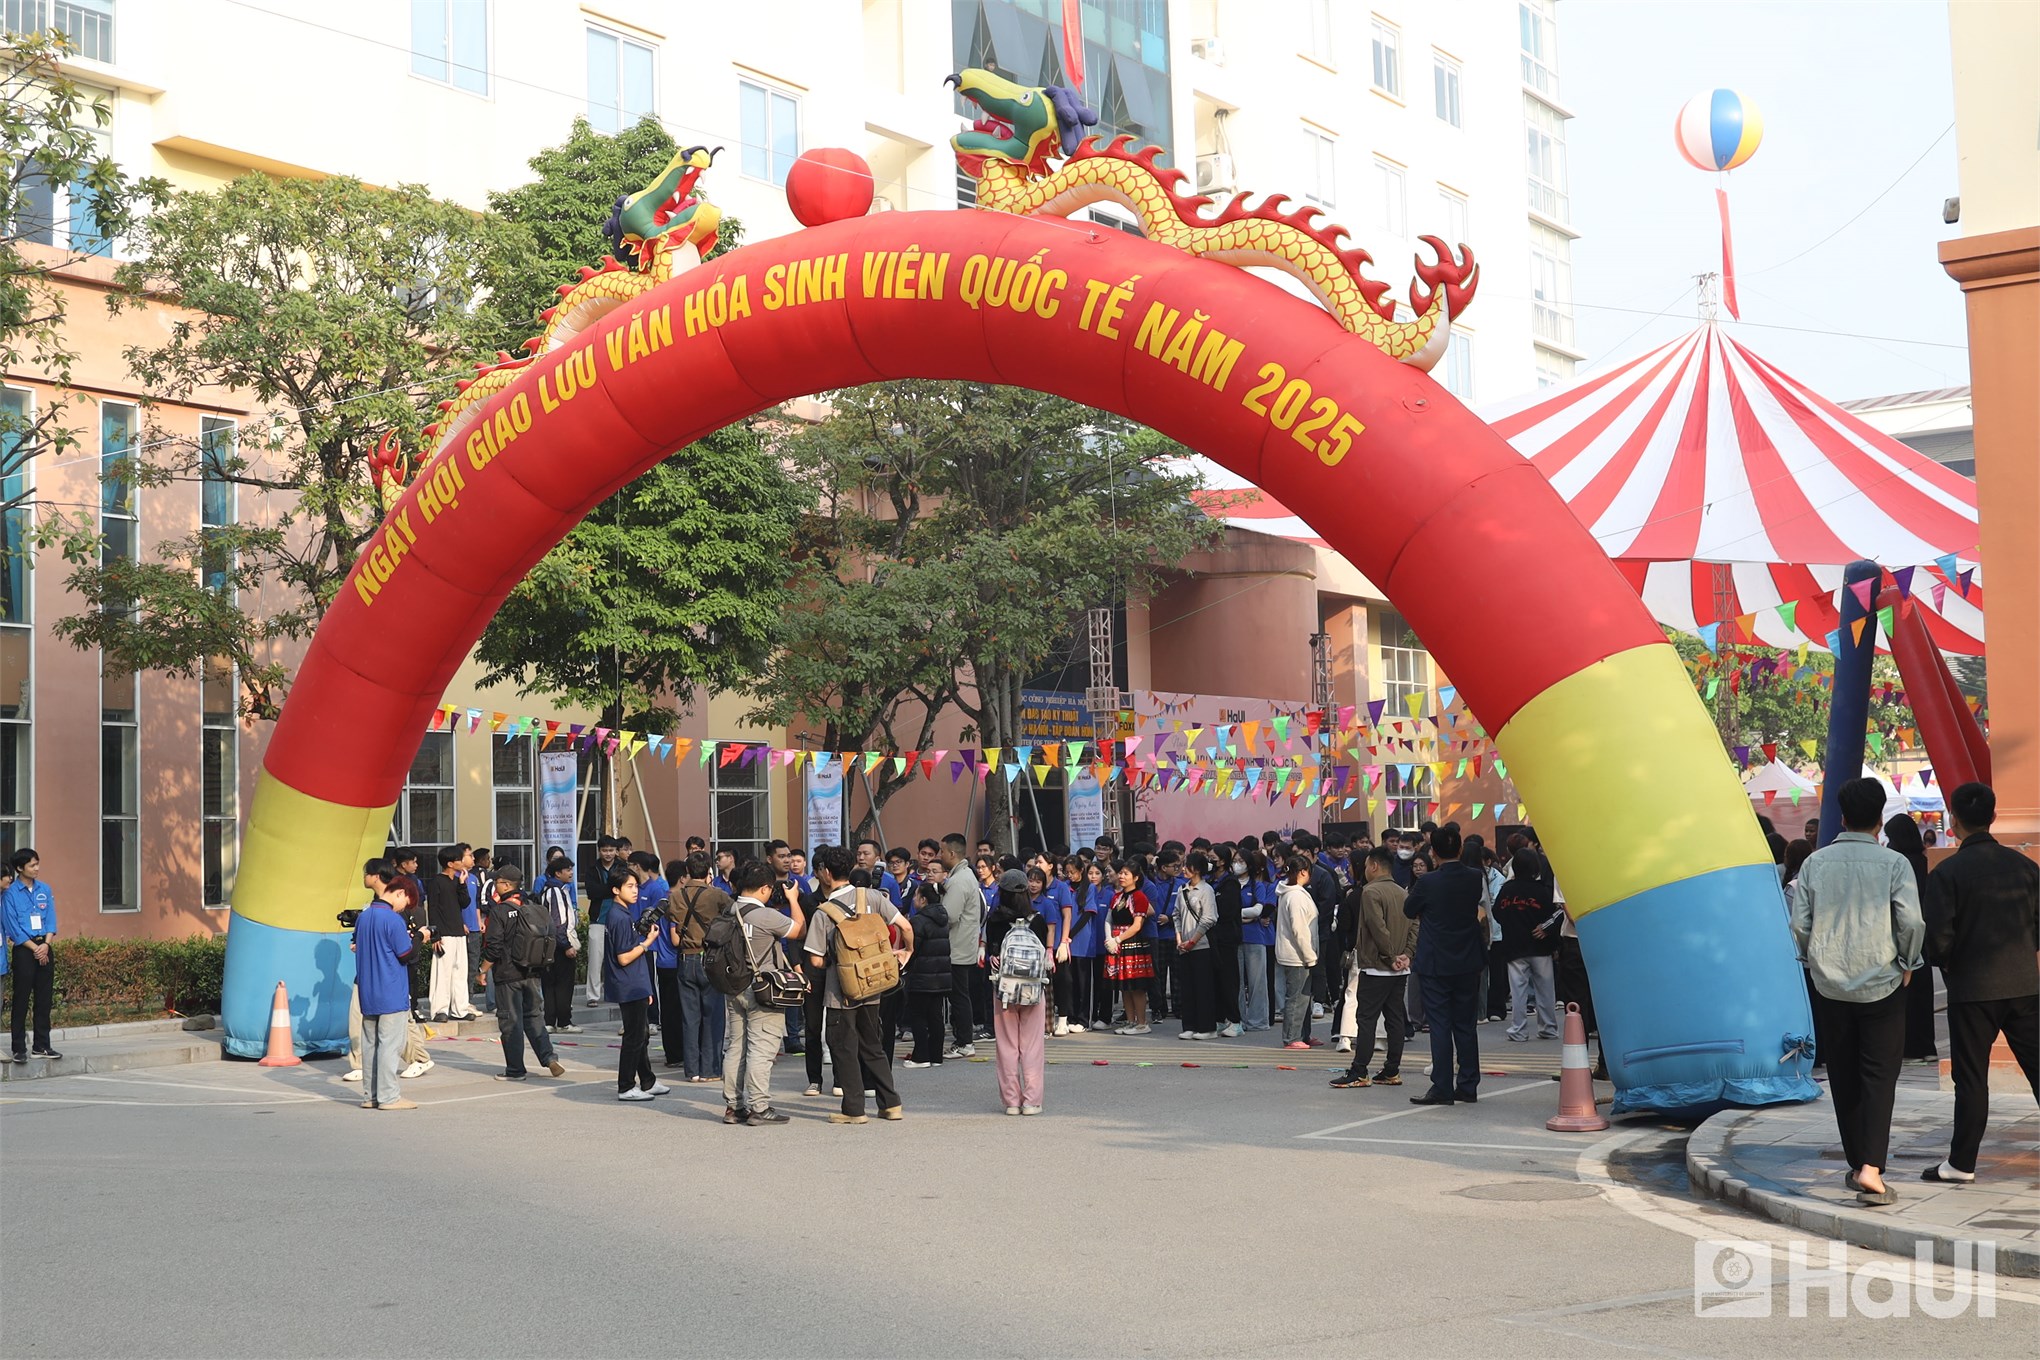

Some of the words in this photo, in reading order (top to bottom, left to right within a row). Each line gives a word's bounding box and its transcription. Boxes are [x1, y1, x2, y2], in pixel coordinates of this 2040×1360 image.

[353, 505, 417, 608] NGÀY
[416, 453, 466, 526] HỘI
[465, 397, 533, 472] GIAO
[537, 344, 598, 415] LƯU
[605, 302, 674, 372] VĂN
[685, 273, 752, 339] HÓA
[762, 251, 849, 311] SINH
[862, 244, 951, 300] VIÊN
[959, 248, 1069, 320] QUỐC
[1079, 274, 1144, 341] TẾ
[1134, 301, 1246, 393] NĂM
[1241, 362, 1367, 468] 2025
[1227, 709, 1246, 723] HaUI
